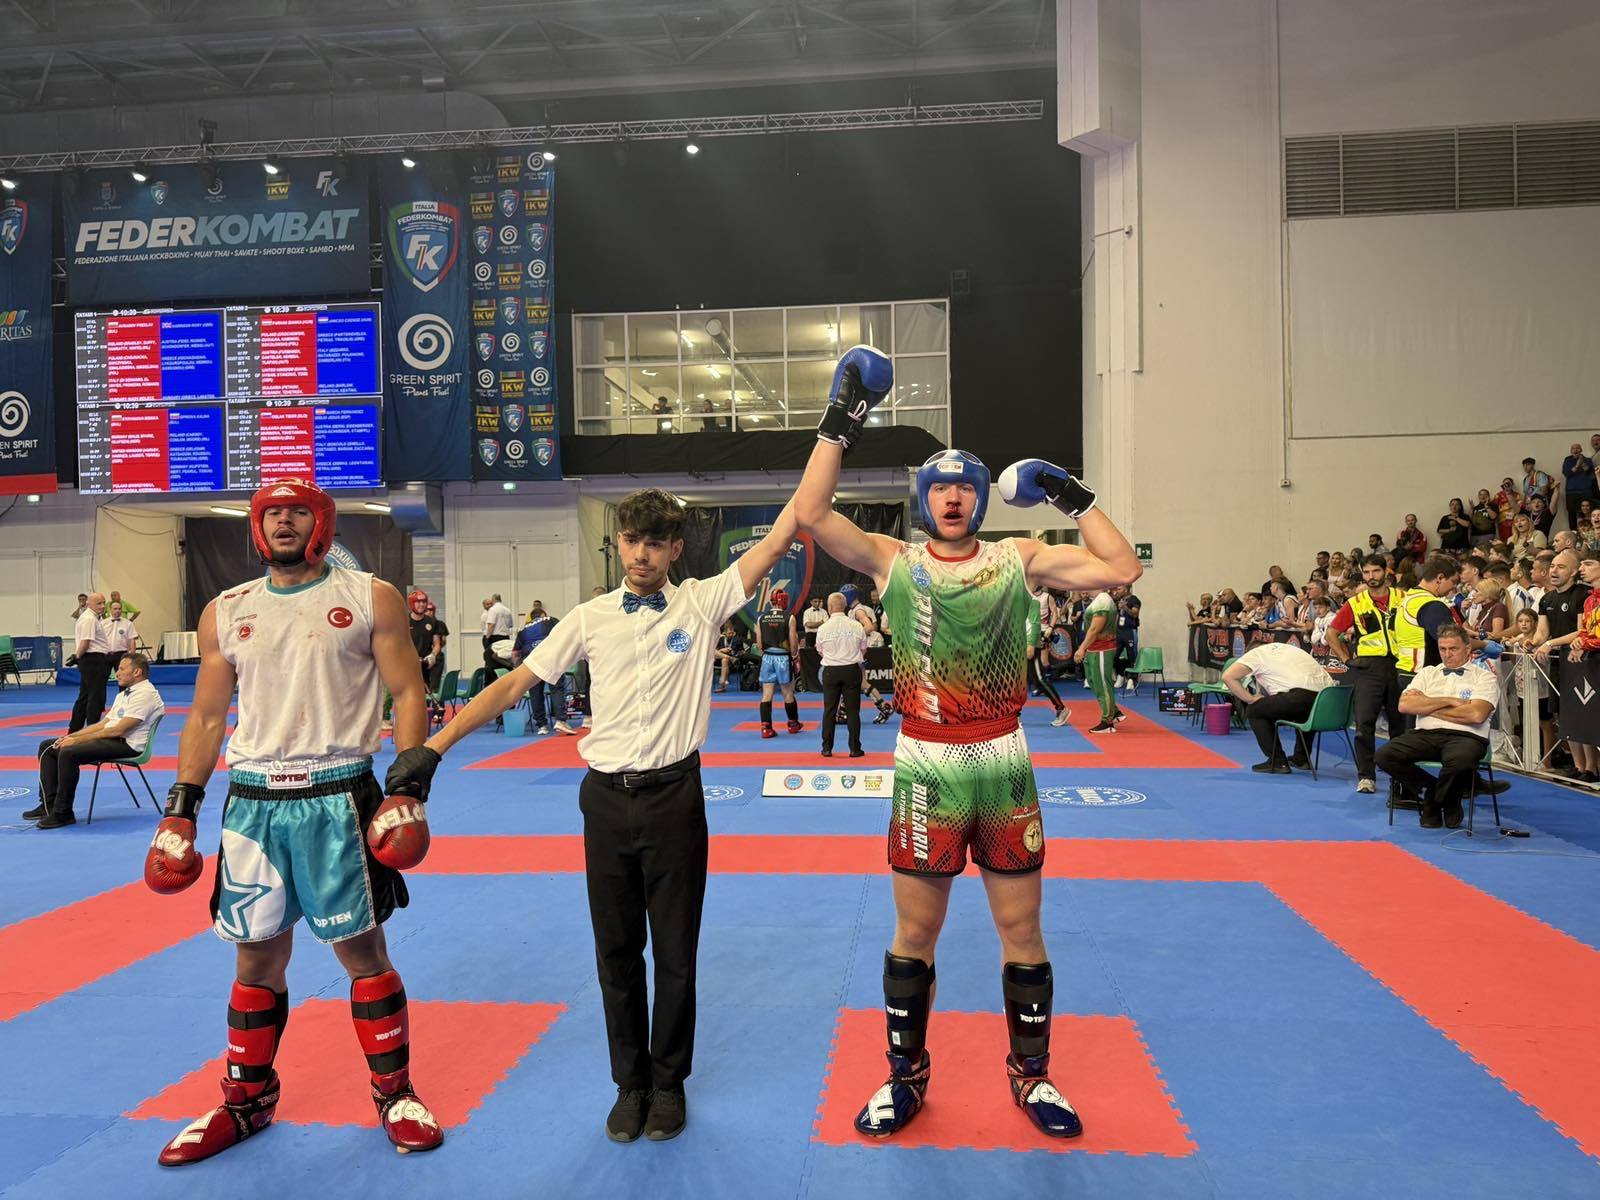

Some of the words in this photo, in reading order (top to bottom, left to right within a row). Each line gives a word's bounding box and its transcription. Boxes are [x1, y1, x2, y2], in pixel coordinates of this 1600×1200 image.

[268, 186, 288, 194] IKW
[397, 214, 453, 225] FEDERKOMBAT
[75, 208, 360, 252] FEDERKOMBAT
[74, 255, 118, 264] FEDERAZIONE
[149, 251, 189, 260] KICKBOXING
[0, 326, 32, 340] RITAS
[390, 374, 424, 384] GREEN
[430, 373, 462, 384] SPIRIT
[502, 384, 524, 392] IKW
[477, 418, 498, 427] IKW
[530, 416, 553, 426] IKW
[13, 440, 38, 449] SPIRIT
[328, 543, 357, 569] BOXING
[865, 669, 893, 680] TAMI
[912, 782, 928, 860] BULGARIA
[328, 911, 352, 926] TEN
